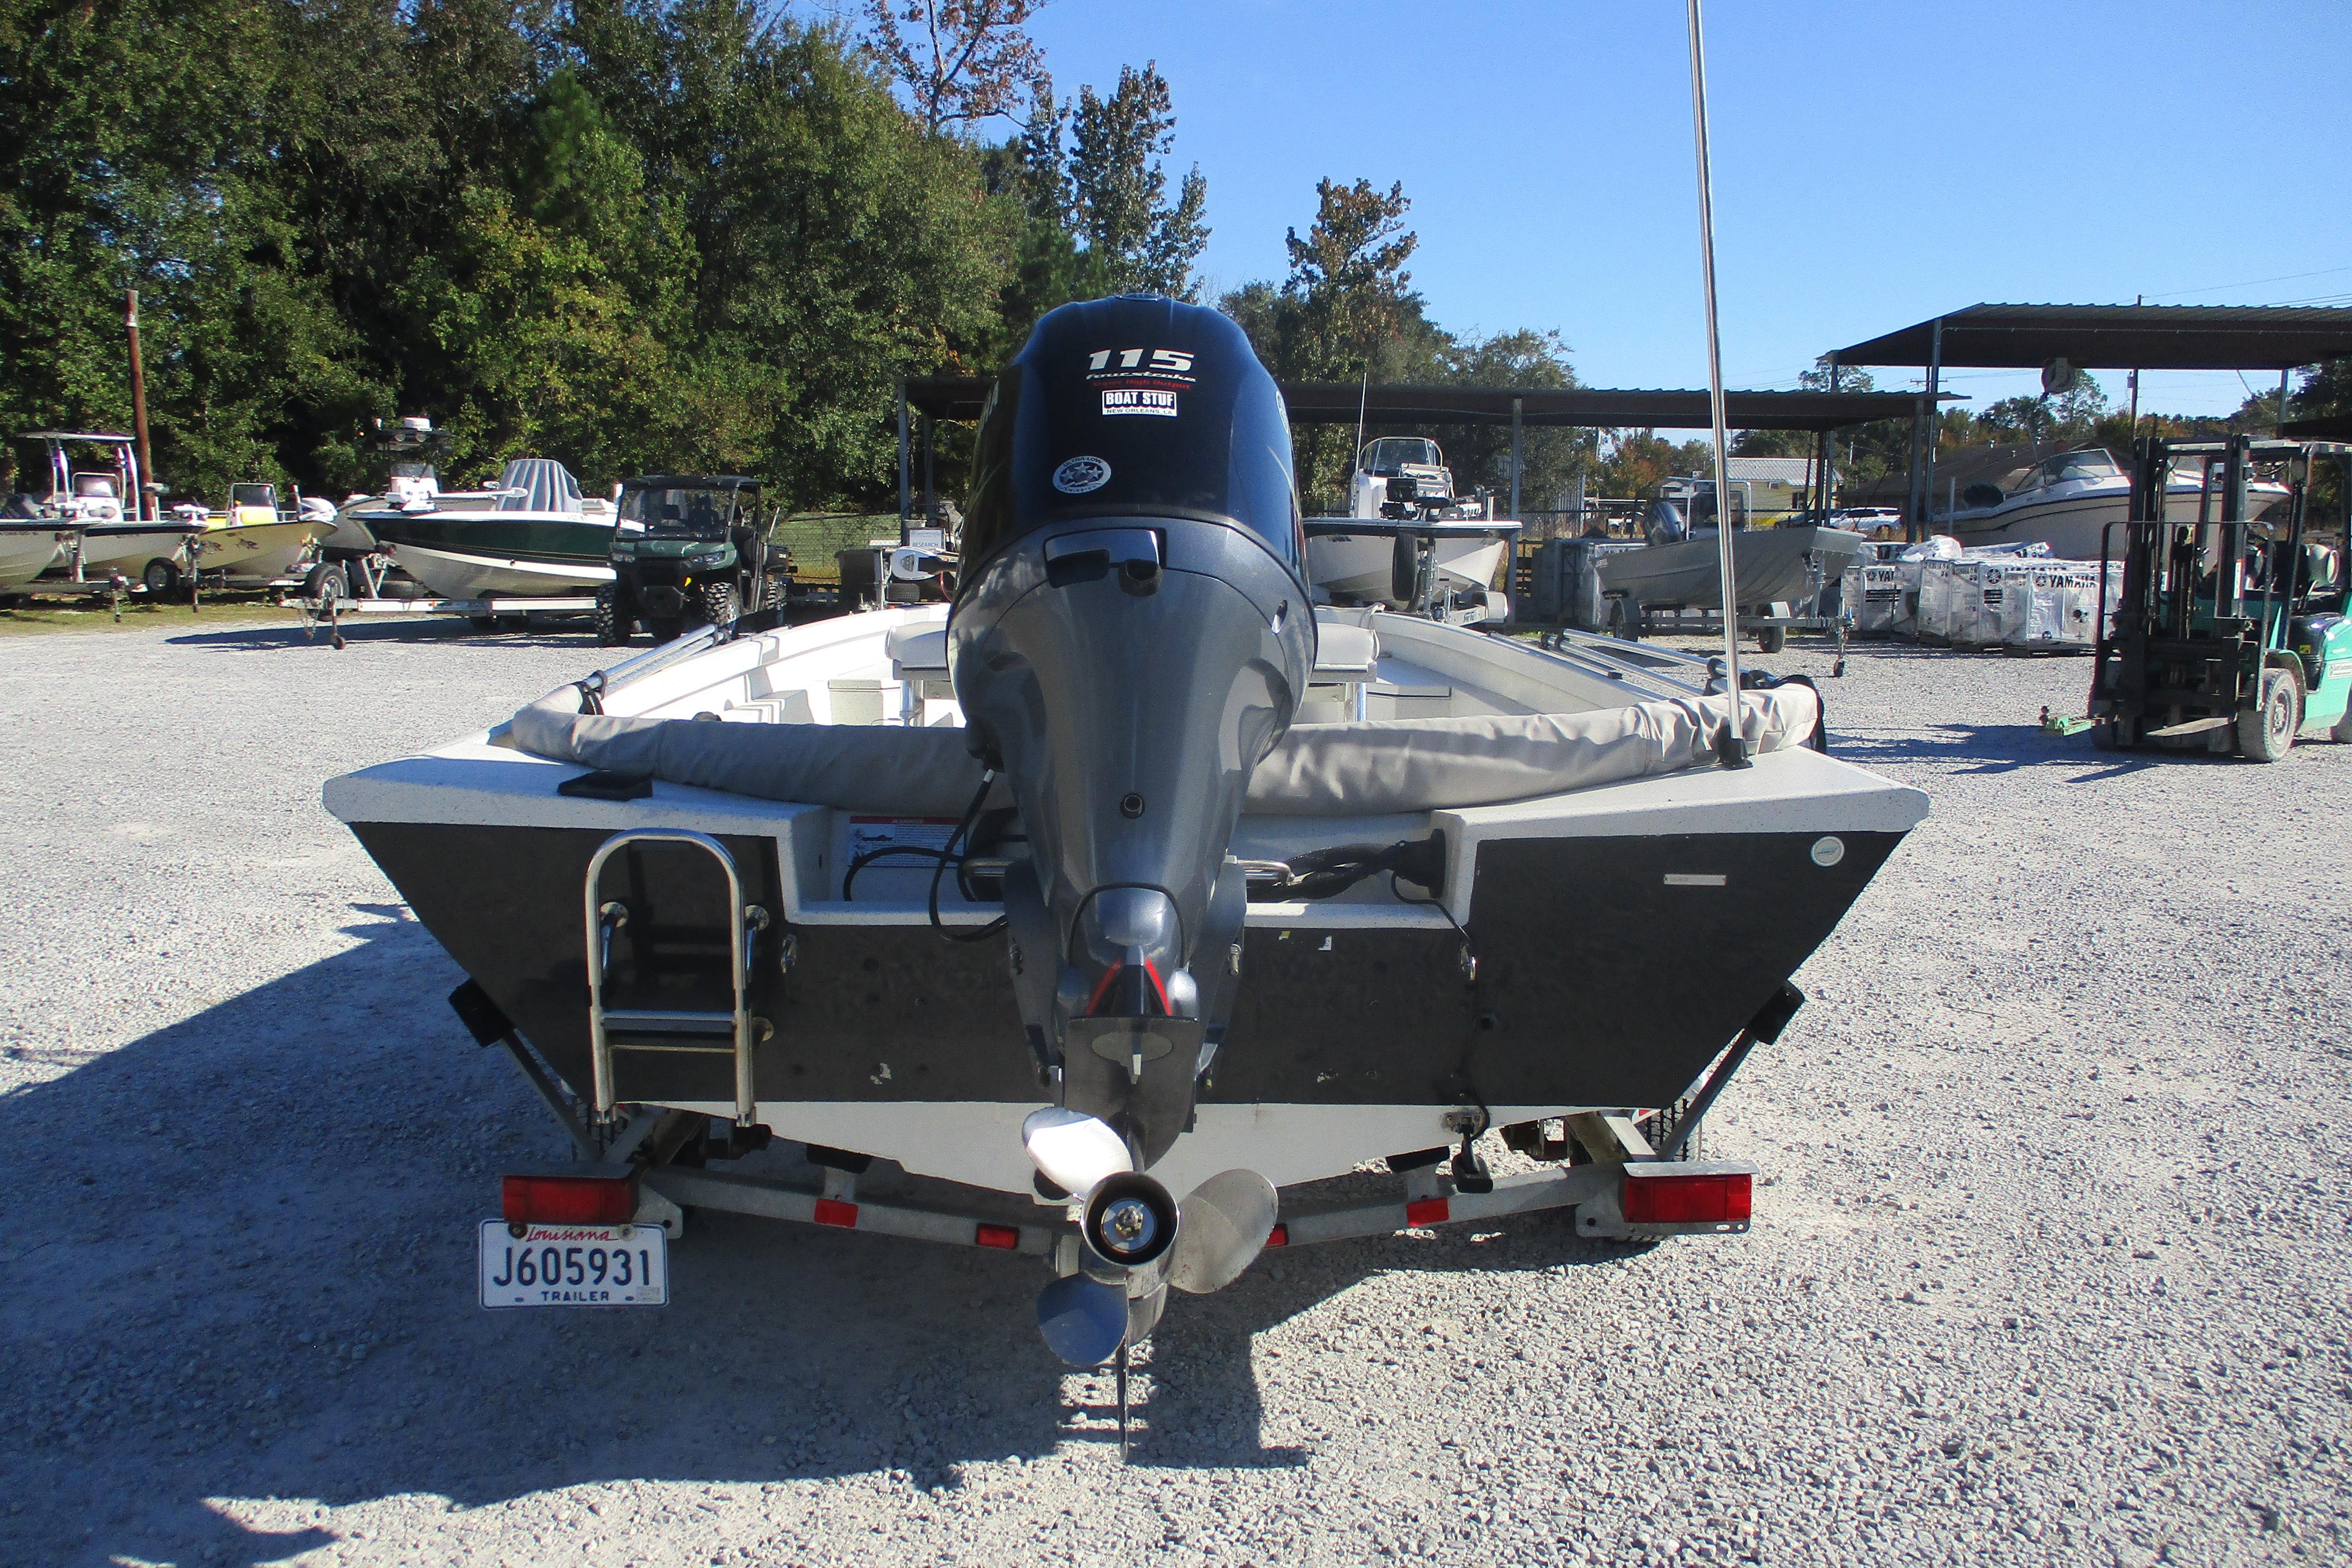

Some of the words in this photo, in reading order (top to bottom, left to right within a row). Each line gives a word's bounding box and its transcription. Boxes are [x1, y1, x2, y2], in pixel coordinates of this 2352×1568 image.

[1089, 348, 1195, 371] 115
[1106, 392, 1139, 405] BOAT
[1142, 392, 1173, 406] STUF
[526, 1226, 619, 1242] Louisiana
[493, 1246, 649, 1286] J605931
[541, 1291, 609, 1301] TRAILER
